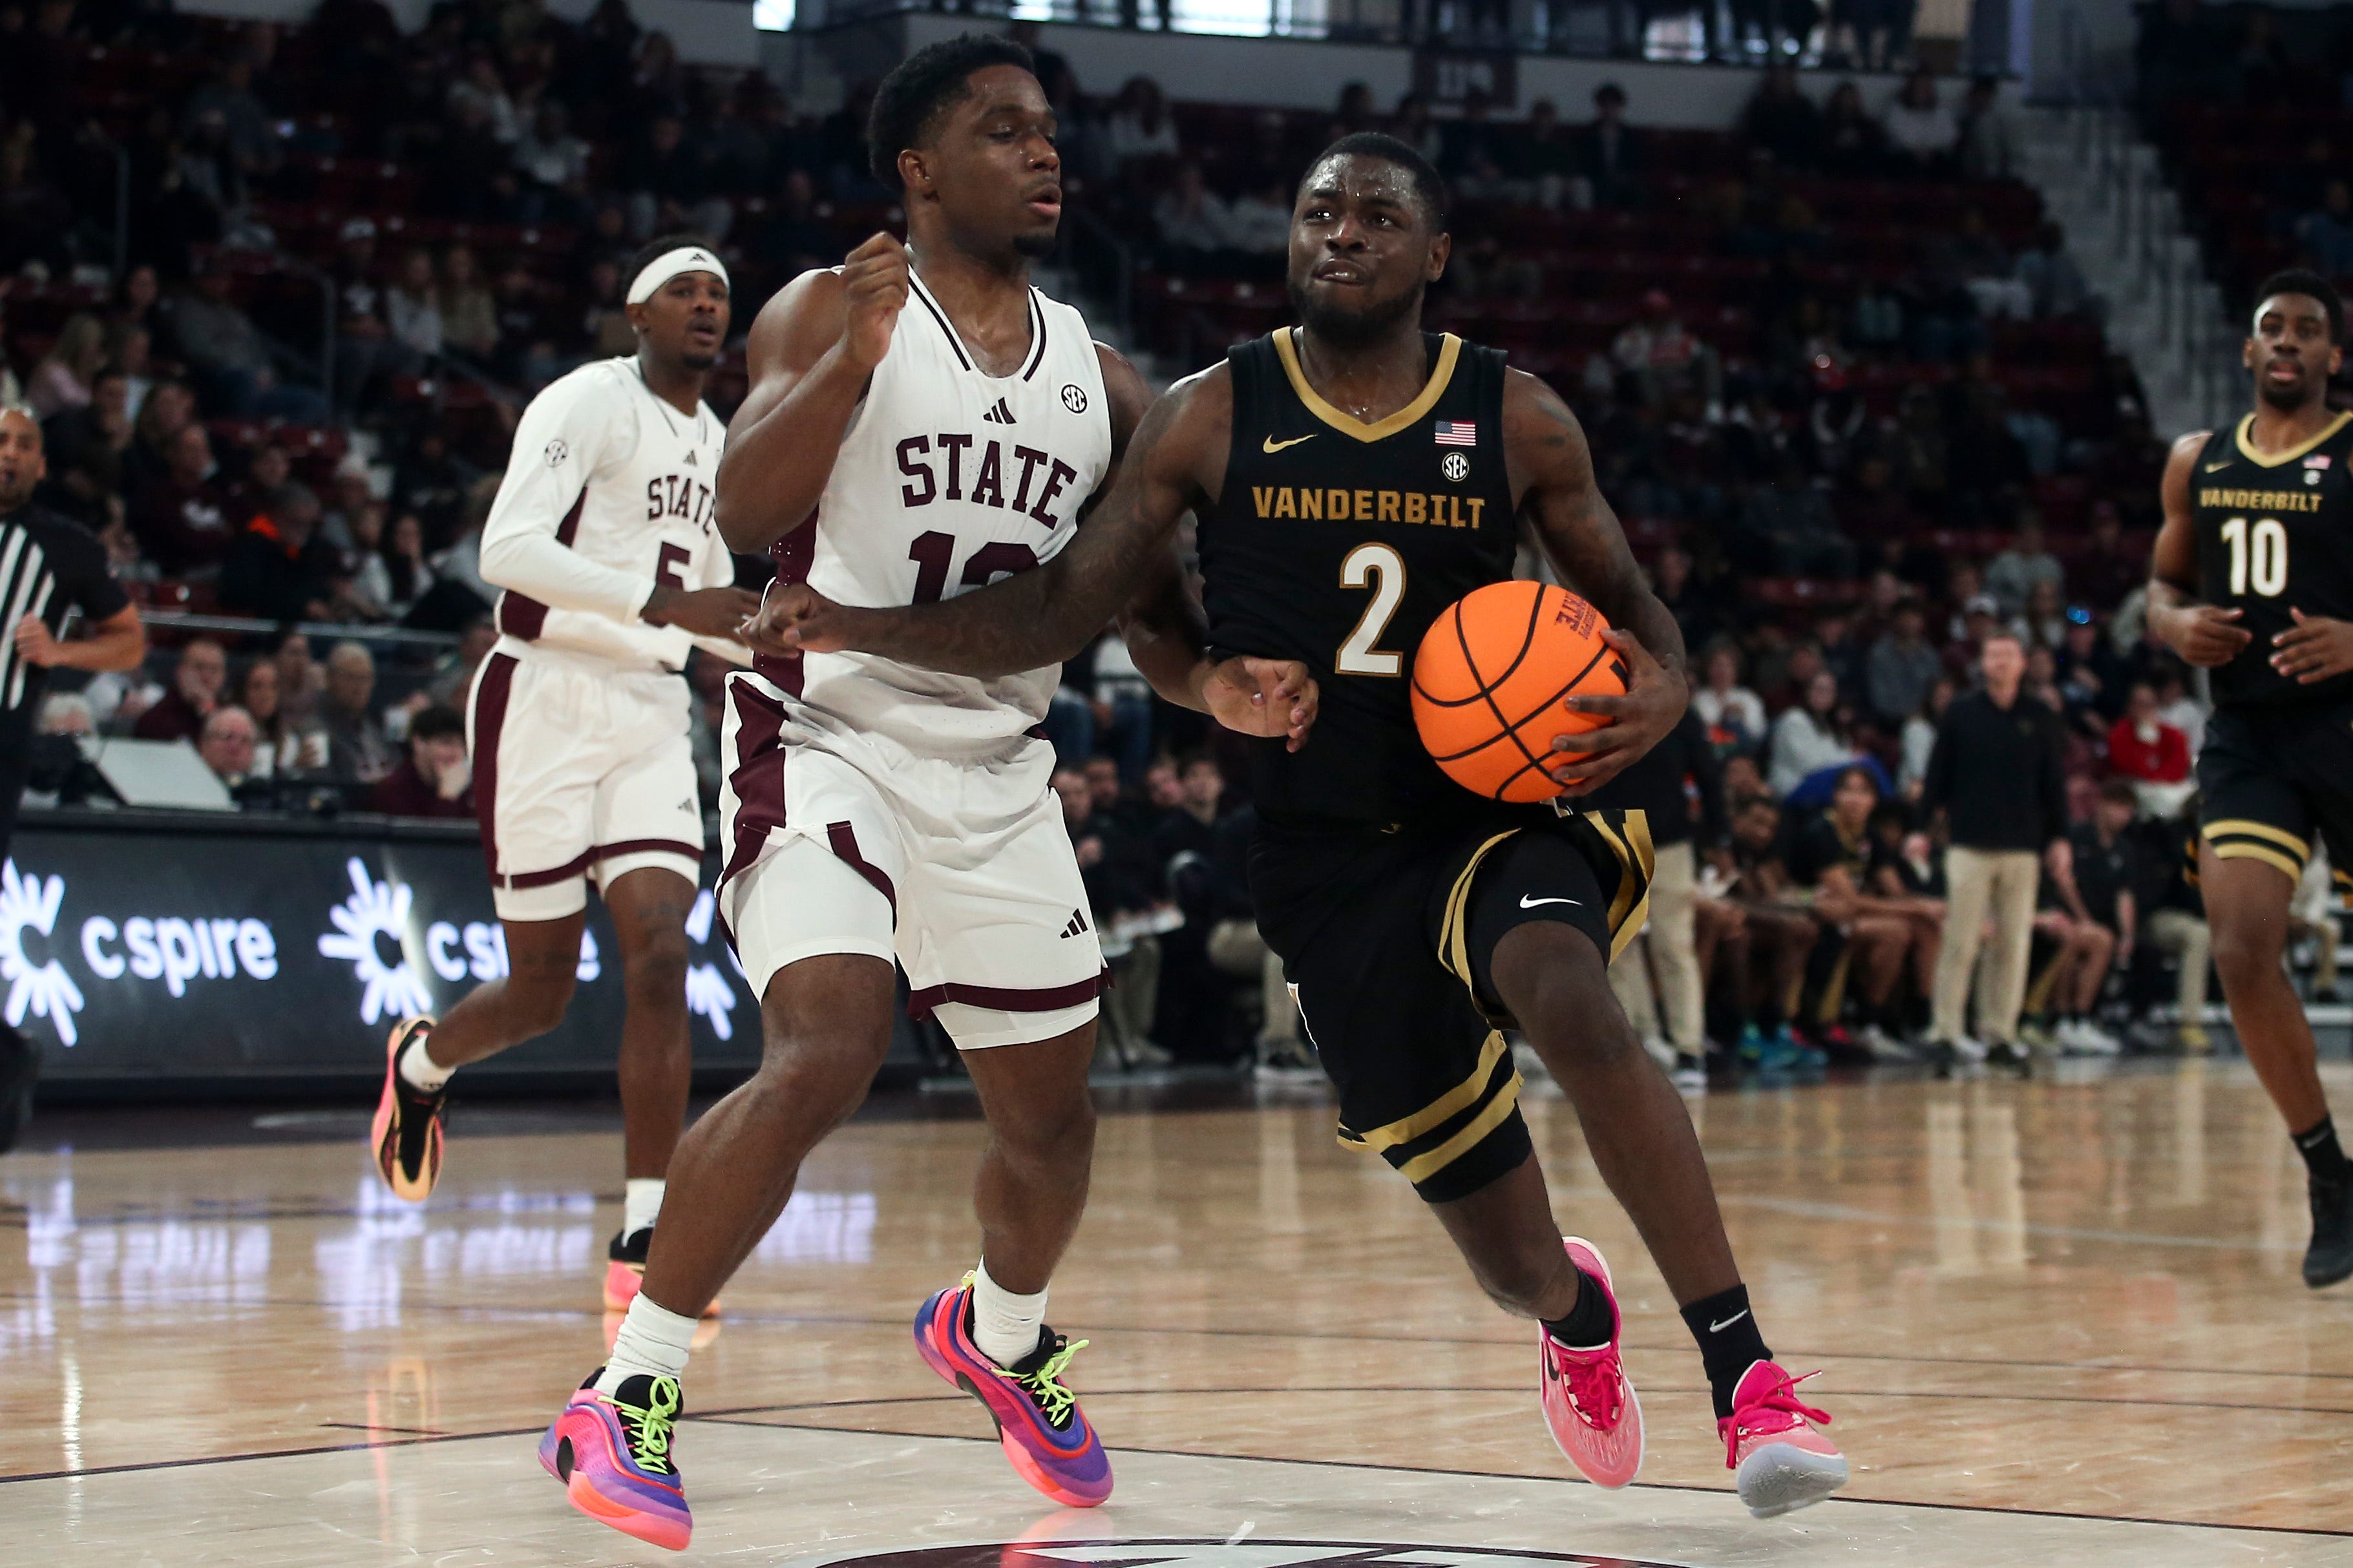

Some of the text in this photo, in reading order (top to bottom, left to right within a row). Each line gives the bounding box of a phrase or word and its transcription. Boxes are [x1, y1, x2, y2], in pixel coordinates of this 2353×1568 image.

[1062, 385, 1087, 413] SEC
[896, 434, 1077, 530] STATE
[1444, 454, 1467, 479] SEC
[1252, 486, 1485, 529] VANDERBILT
[2199, 487, 2323, 513] VANDERBILT
[2221, 517, 2288, 598] 10
[1335, 541, 1406, 677] 2
